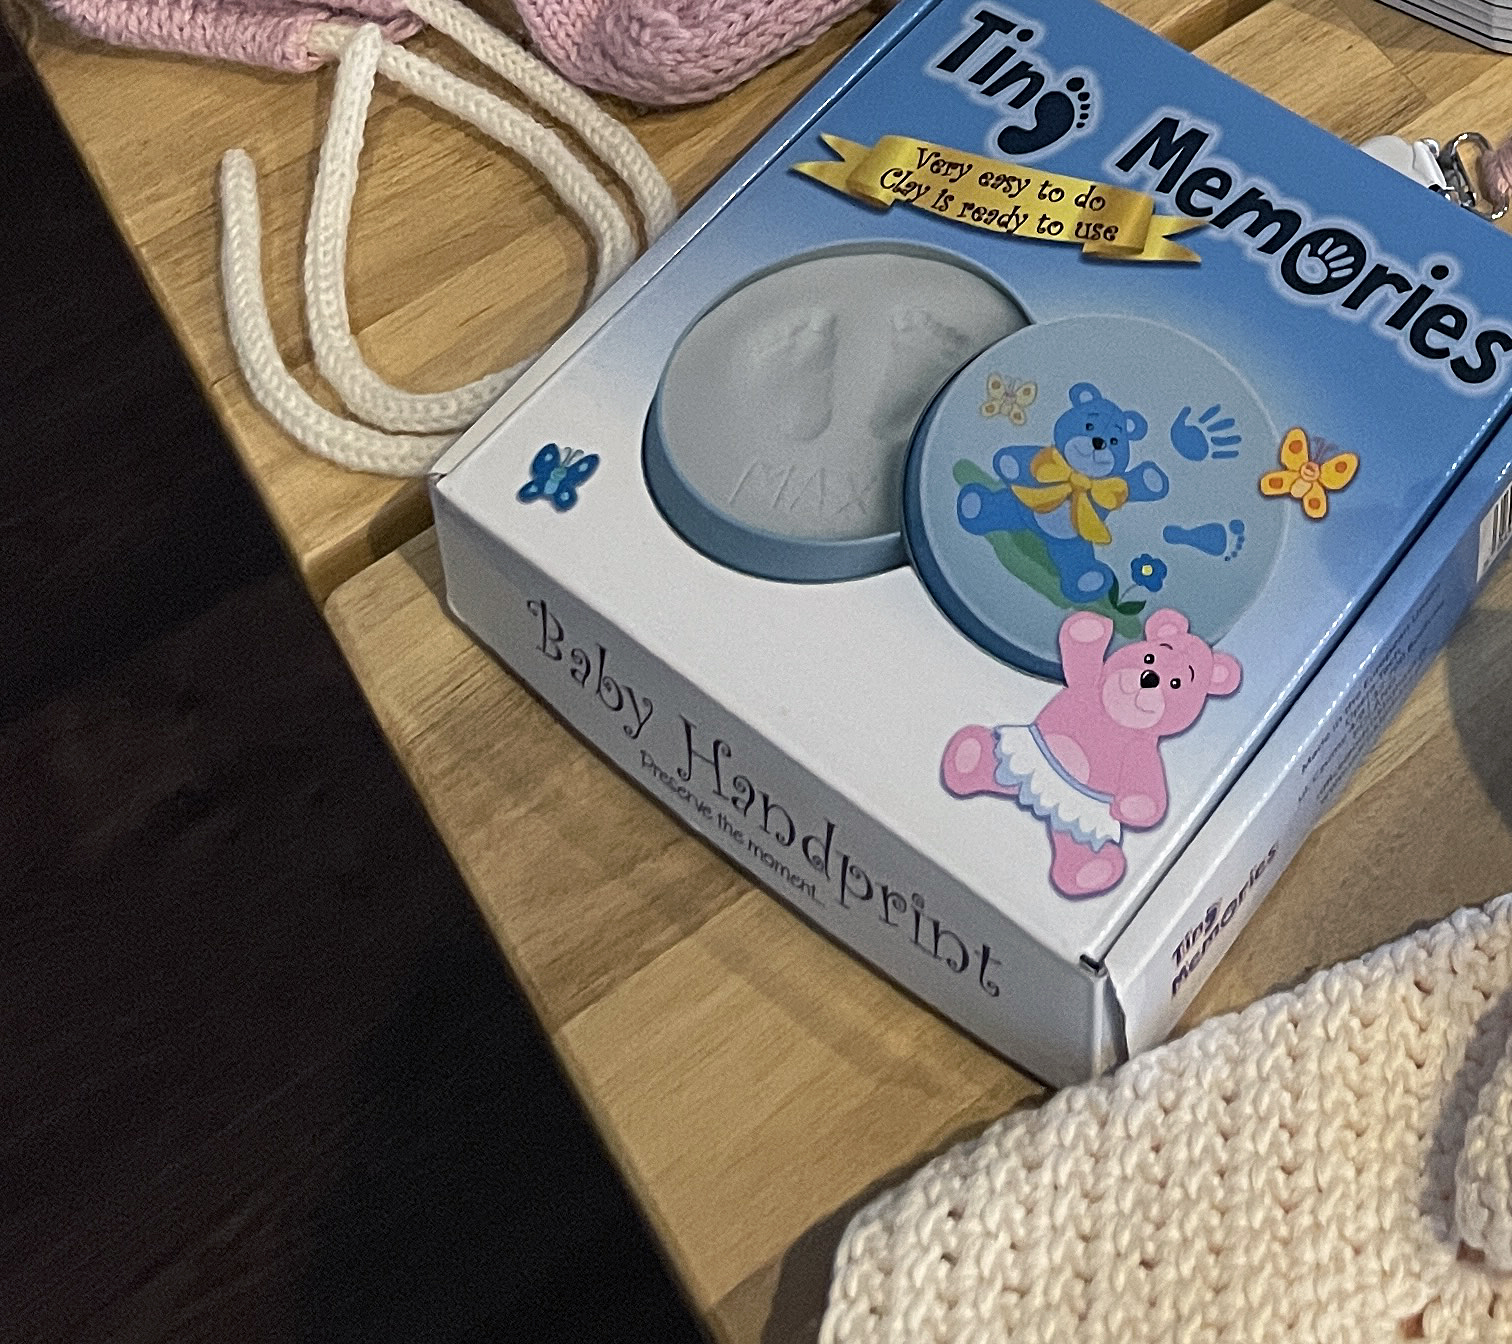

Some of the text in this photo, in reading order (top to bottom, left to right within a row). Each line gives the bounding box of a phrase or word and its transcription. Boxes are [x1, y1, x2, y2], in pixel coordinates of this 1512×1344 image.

[936, 7, 1094, 156] Tiny
[880, 167, 1120, 243] Clay is ready to use
[916, 146, 1107, 212] Very easy to do
[526, 598, 1002, 999] Baby Handprint
[640, 749, 713, 820] Preserve
[717, 812, 745, 845] the
